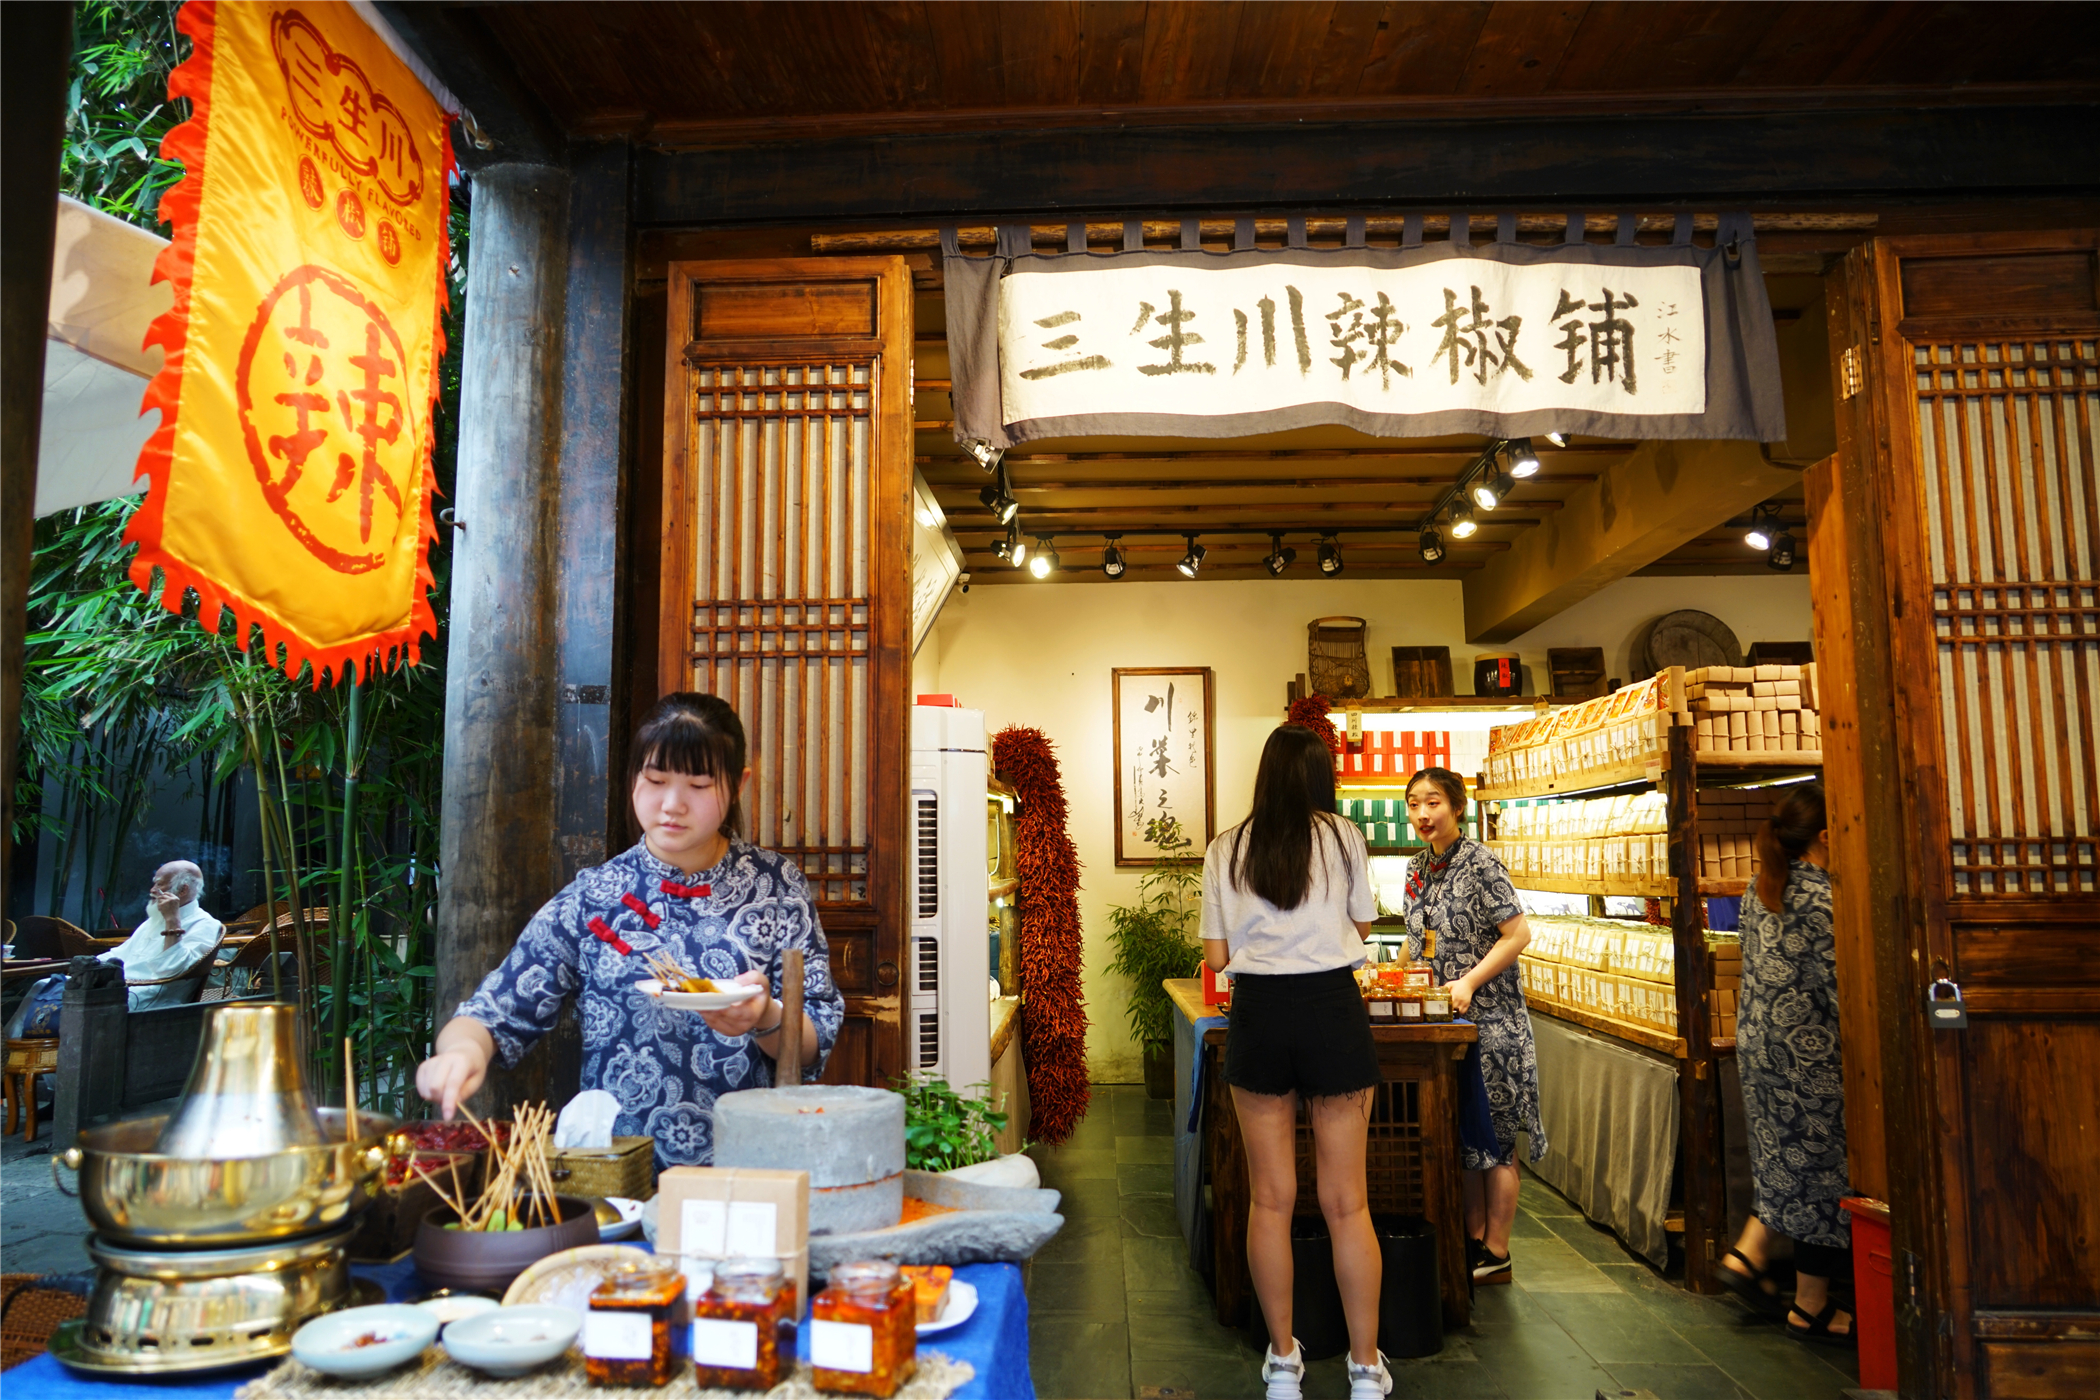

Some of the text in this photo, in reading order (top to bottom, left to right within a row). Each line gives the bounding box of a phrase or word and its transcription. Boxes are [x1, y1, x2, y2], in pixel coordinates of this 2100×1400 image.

[280, 106, 422, 242] POWERFULLY FLAVORED
[292, 41, 402, 180] 三生川
[1018, 283, 1640, 397] 三生川辣椒铺
[268, 281, 403, 545] 辣
